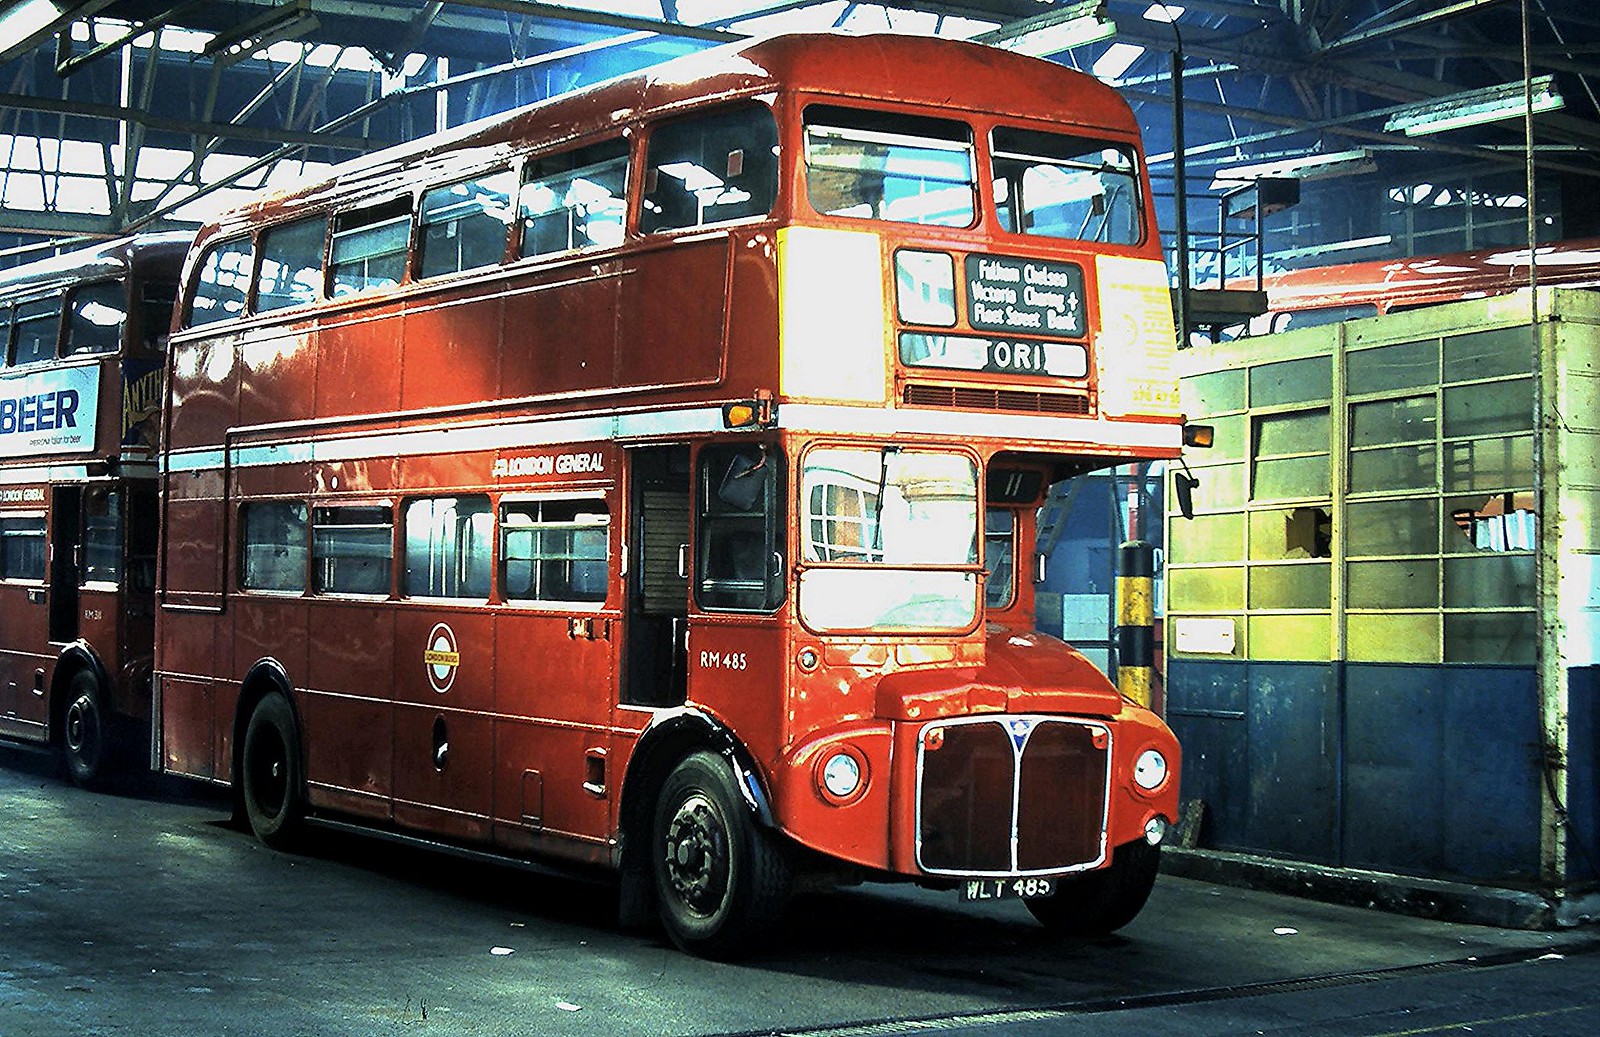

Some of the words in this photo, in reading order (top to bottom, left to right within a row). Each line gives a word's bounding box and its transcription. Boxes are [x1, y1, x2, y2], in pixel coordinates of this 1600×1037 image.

[1023, 263, 1068, 288] Chelsea
[971, 280, 1017, 305] Victoria
[0, 389, 79, 435] BEER
[508, 455, 555, 477] LONDON
[556, 452, 604, 474] GENERAL
[700, 650, 720, 668] RM
[722, 652, 747, 670] 485
[967, 880, 1006, 899] WLT
[1013, 879, 1051, 896] 485
